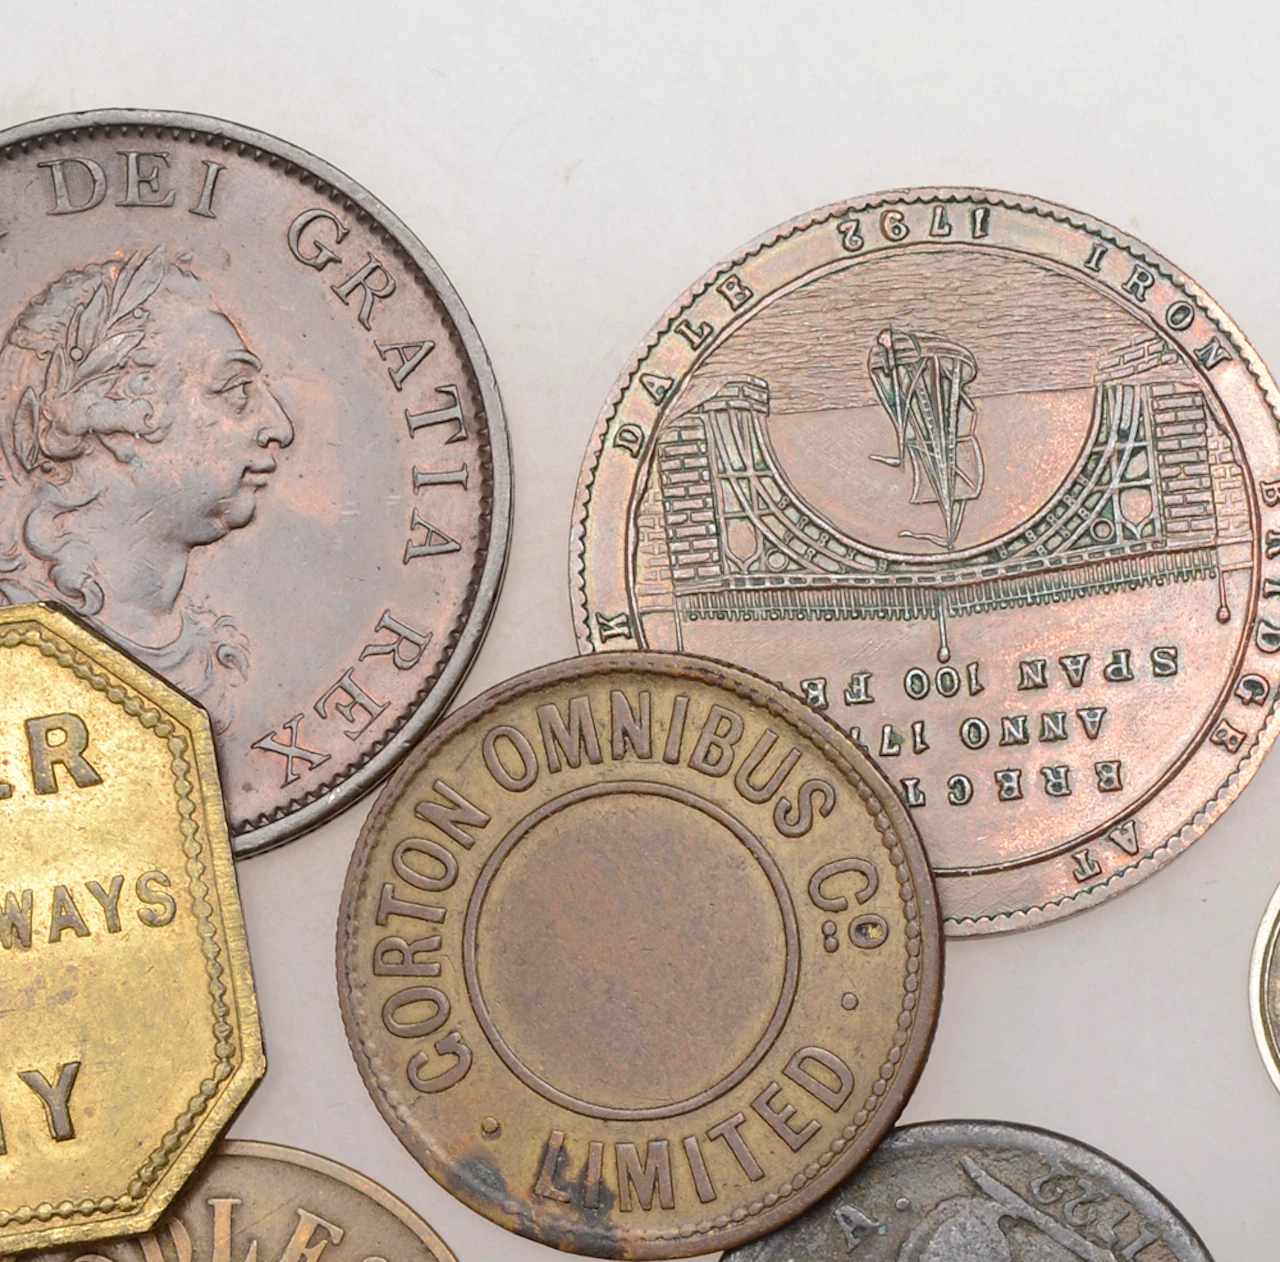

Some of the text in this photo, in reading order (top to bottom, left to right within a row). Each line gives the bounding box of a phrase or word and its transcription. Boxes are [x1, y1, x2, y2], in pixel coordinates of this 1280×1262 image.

[37, 150, 228, 219] DEI
[836, 208, 990, 252] 1792
[1082, 244, 1234, 371] IRON
[286, 208, 470, 566] GRATIA
[613, 272, 754, 458] DALE
[251, 609, 435, 786] REX
[903, 665, 984, 698] 100
[1019, 647, 1179, 690] SPAN
[960, 707, 1108, 749] ANNO
[372, 780, 492, 1094] GORTON
[481, 689, 837, 838] OMNIBUS
[1073, 819, 1142, 883] AT
[531, 1045, 856, 1212] LIMITED
